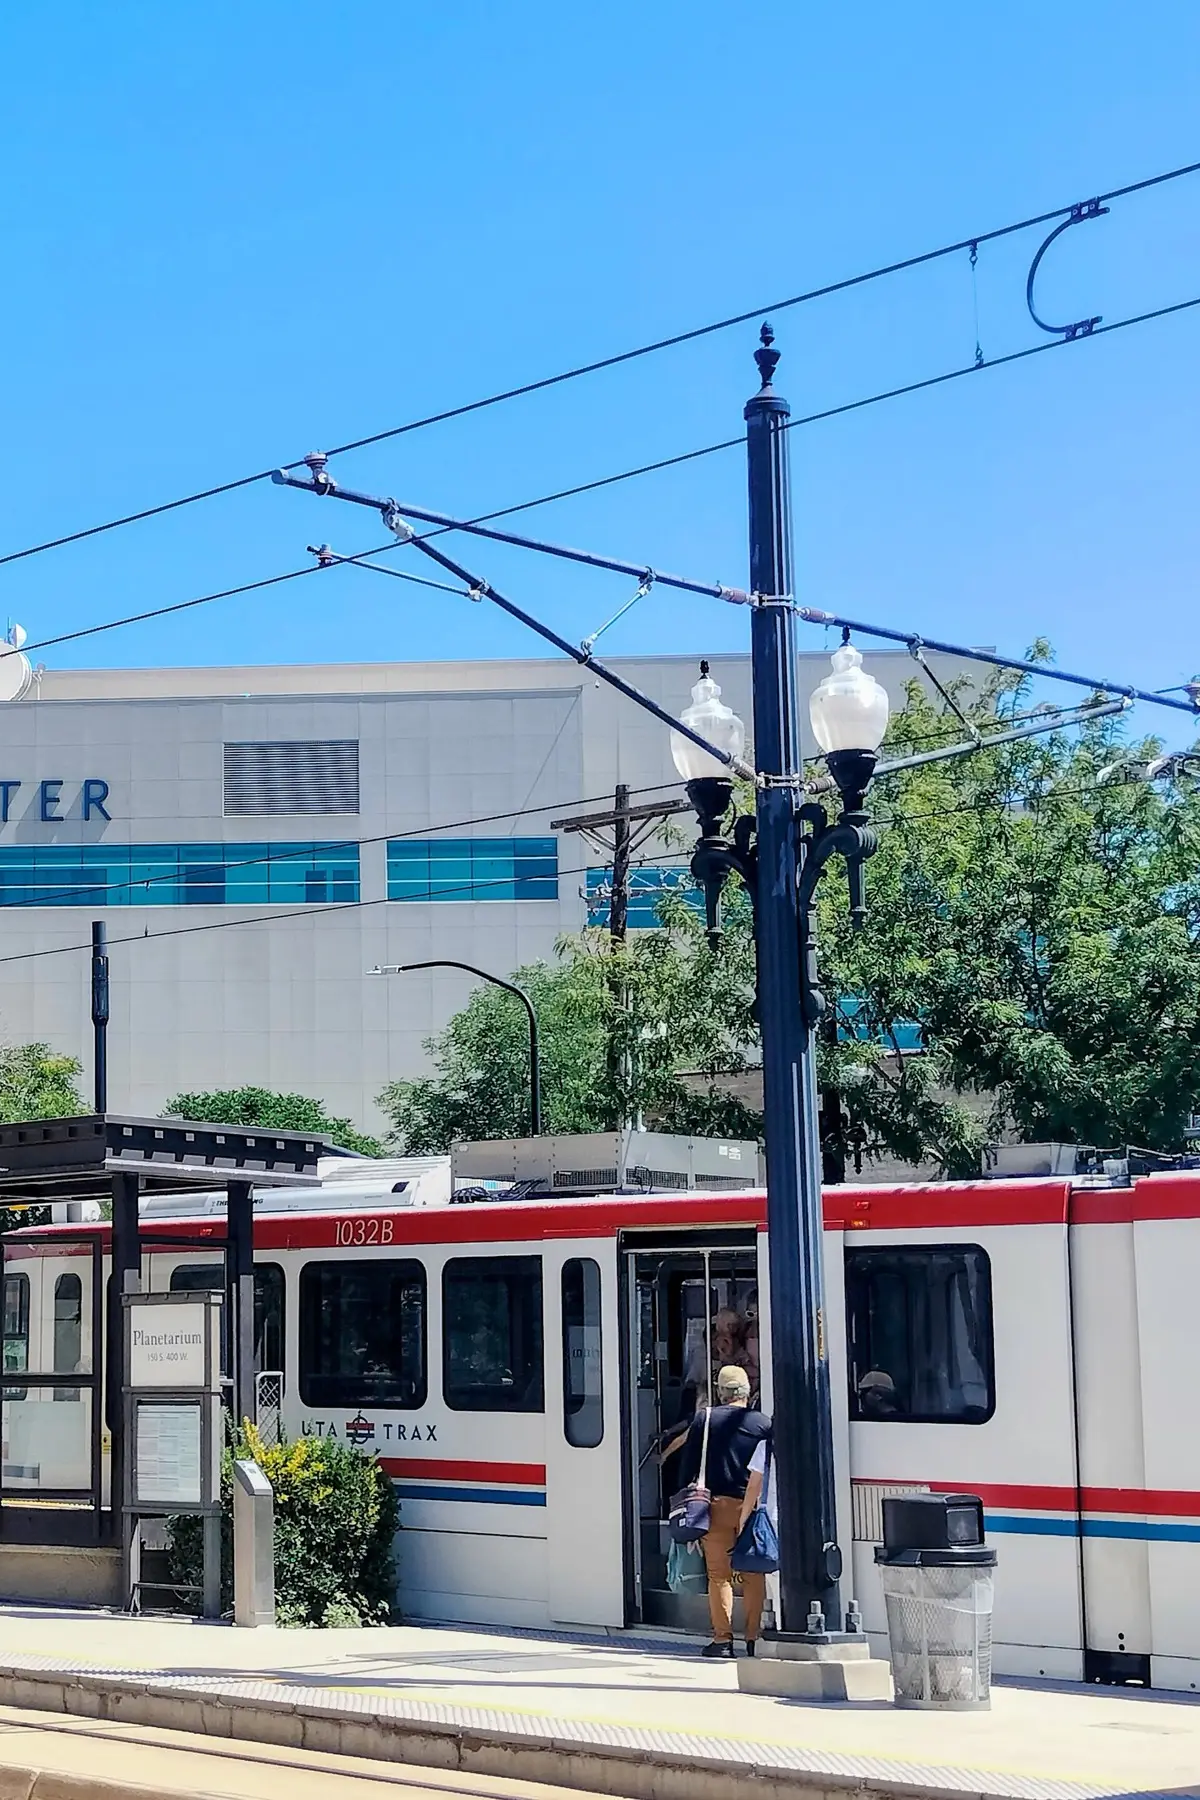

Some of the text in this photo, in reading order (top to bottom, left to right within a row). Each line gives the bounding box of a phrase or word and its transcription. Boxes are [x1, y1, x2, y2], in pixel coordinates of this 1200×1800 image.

[335, 1219, 393, 1245] 1032B
[133, 1330, 202, 1346] Planetarium
[166, 1352, 179, 1361] 400
[301, 1420, 337, 1437] UTA
[383, 1423, 438, 1441] TRAX
